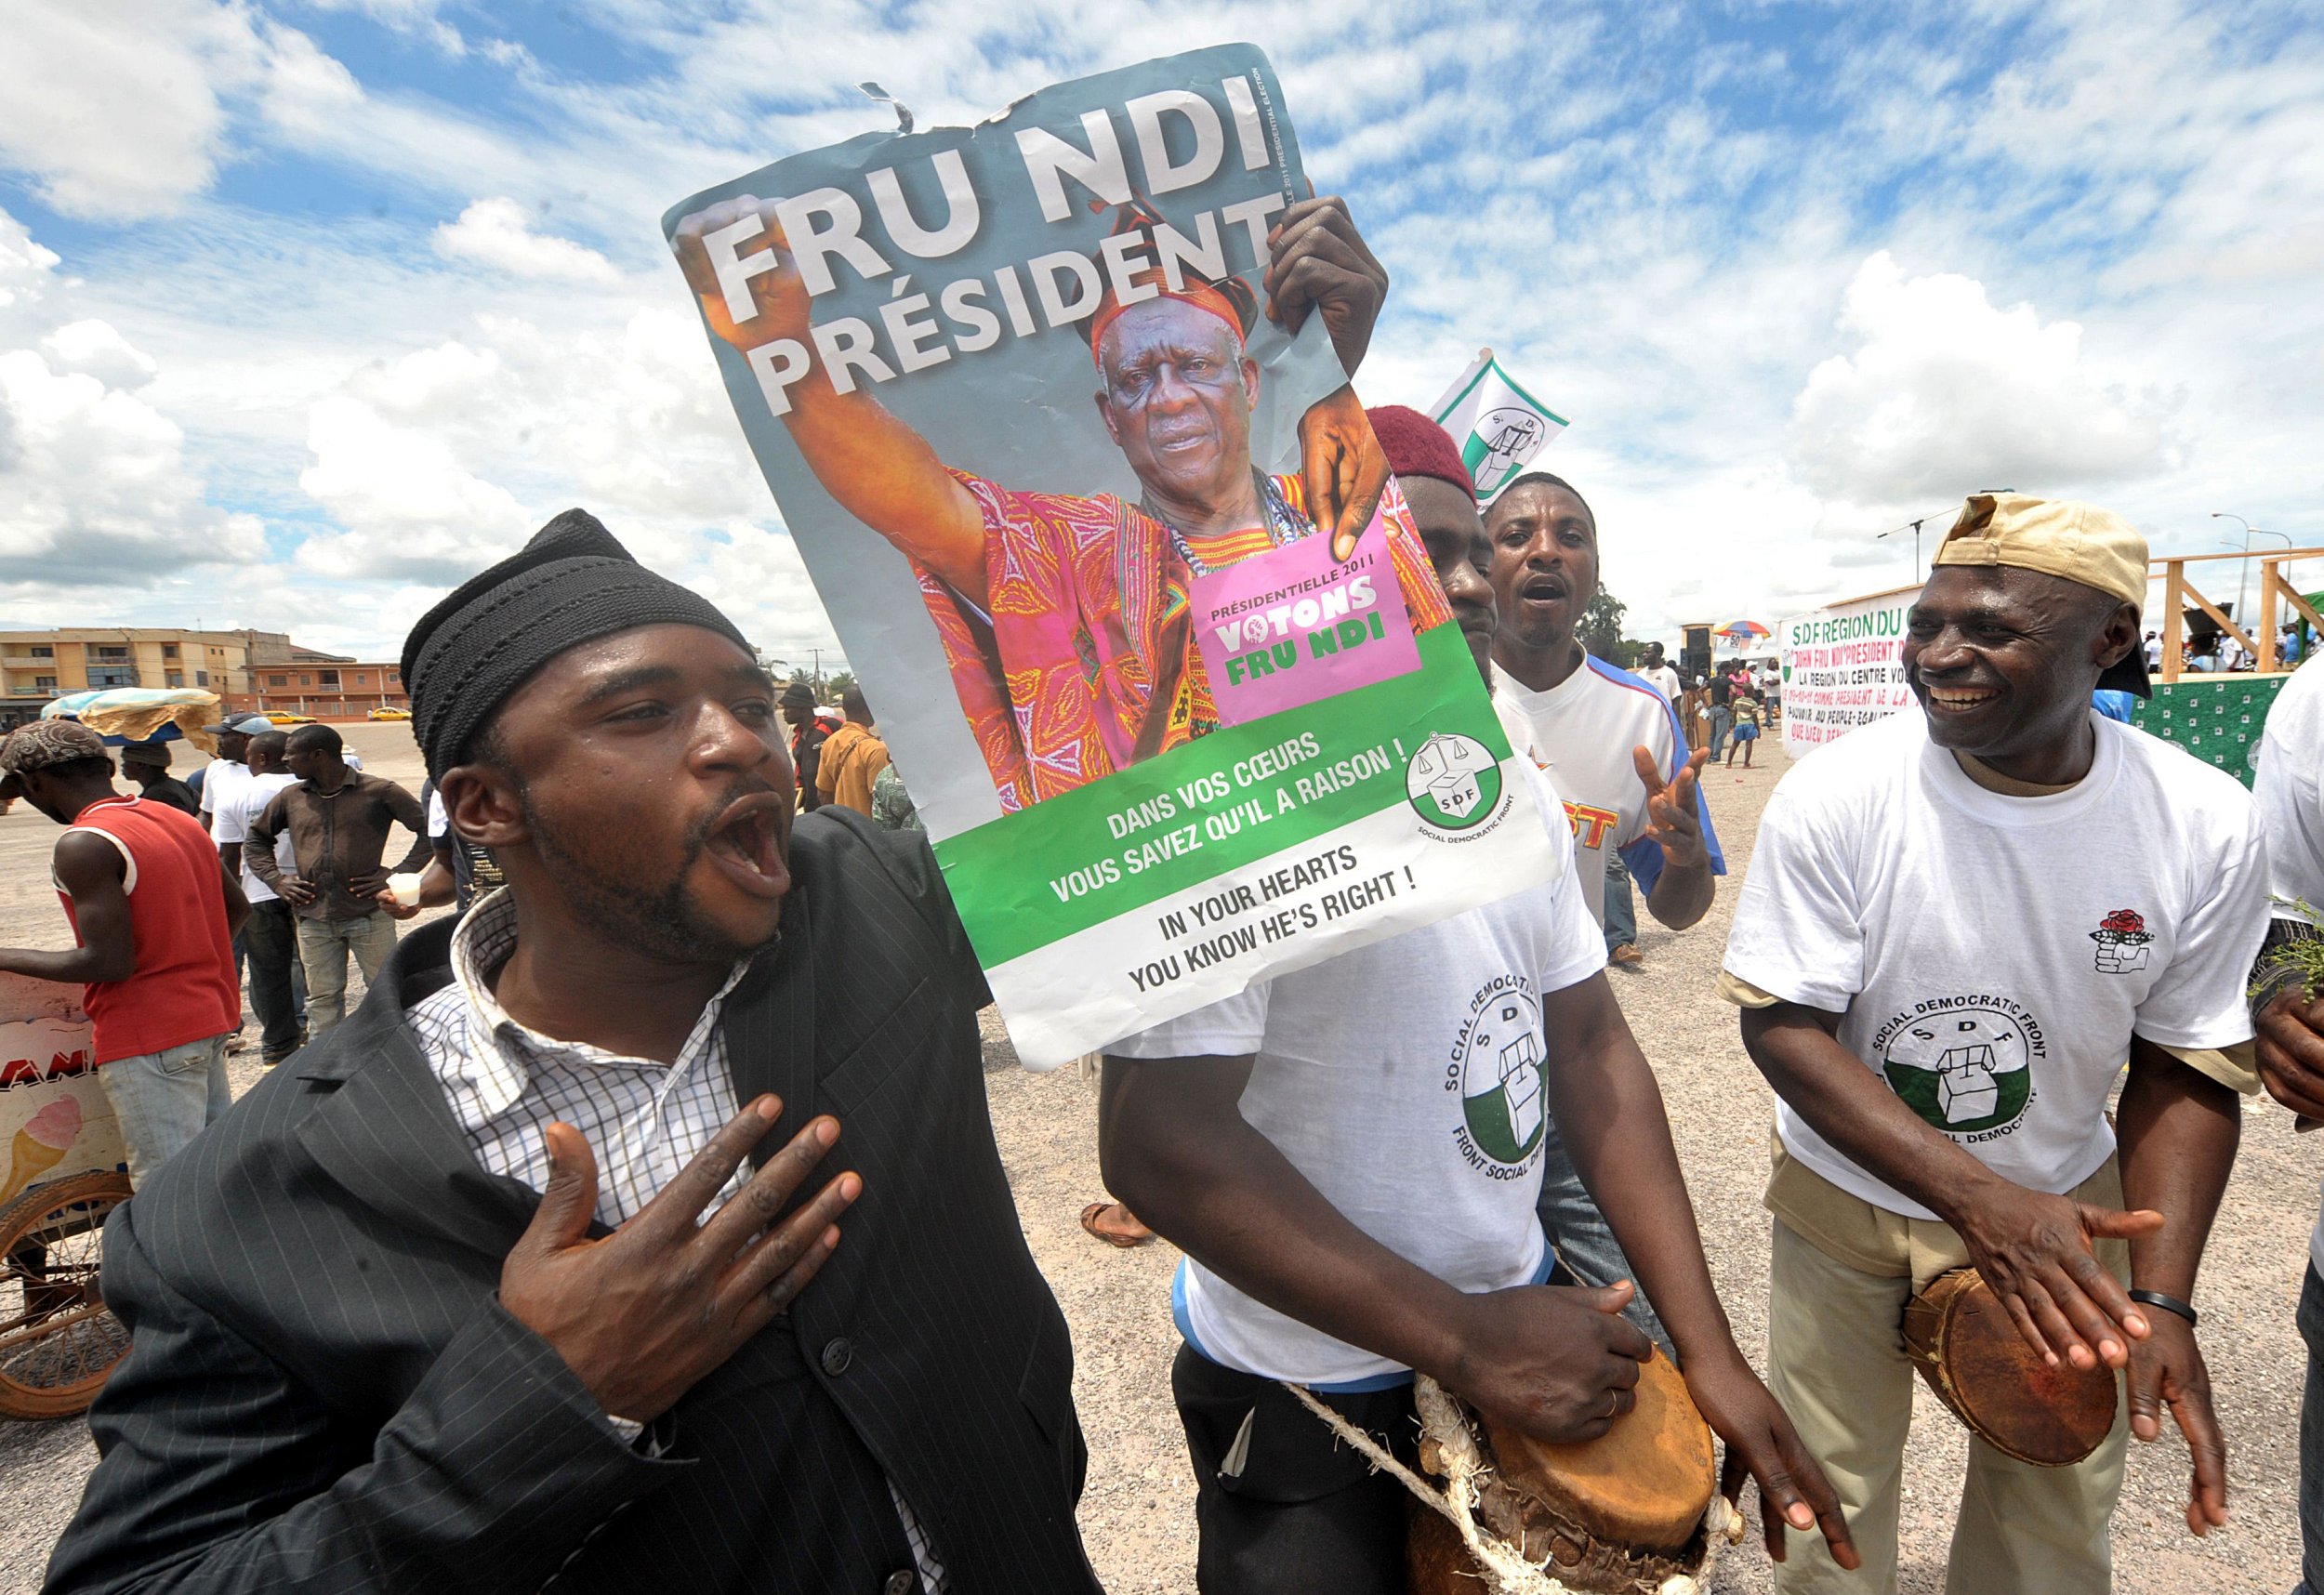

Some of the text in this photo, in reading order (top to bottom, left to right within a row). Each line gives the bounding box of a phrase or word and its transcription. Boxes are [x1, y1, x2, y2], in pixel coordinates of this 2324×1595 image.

[1251, 67, 1271, 105] ELECTION
[1266, 106, 1287, 168] PRESIDENTIAL
[702, 75, 1273, 324] FRU NDI
[1282, 169, 1292, 189] 2011
[746, 191, 1287, 417] PRÉSIDENT
[1210, 554, 1374, 622] PRÉSIDENTIELLE 2011
[1215, 575, 1377, 652] VOTONS
[1225, 611, 1385, 686] FRU NDI
[1730, 635, 1741, 646] 50
[1815, 649, 1829, 668] FRU
[1845, 640, 1894, 666] PRESIDENT
[1823, 611, 1874, 643] REGION
[1877, 608, 1901, 636] DU
[1799, 672, 1808, 686] LA
[1810, 671, 1836, 687] REGION
[1839, 671, 1849, 686] DU
[1851, 668, 1886, 686] CENTRE
[1814, 691, 1833, 706] COMME
[1835, 689, 1872, 706] PRESIDENT
[1876, 689, 1886, 705] DE
[1892, 689, 1908, 706] LA
[1791, 723, 1803, 741] QUE
[1805, 724, 1822, 744] DIEU
[1816, 710, 1825, 723] AU
[1106, 732, 1320, 839] DANS VOS CŒURS
[1050, 738, 1407, 903] VOUS SAVEZ QU'IL A RAISON !
[1417, 794, 1514, 844] SOCIAL DEMOCRATIC FRONT
[1158, 845, 1357, 941] IN YOUR HEARTS
[1129, 865, 1417, 993] YOU KNOW HE’S RIGHT !
[1445, 1018, 1473, 1092] SOCIAL
[1872, 995, 2046, 1059] SOCIAL DEMOCRATIC FRONT
[1452, 1125, 1487, 1171] FRONT
[1486, 1163, 1528, 1181] SOCIAL
